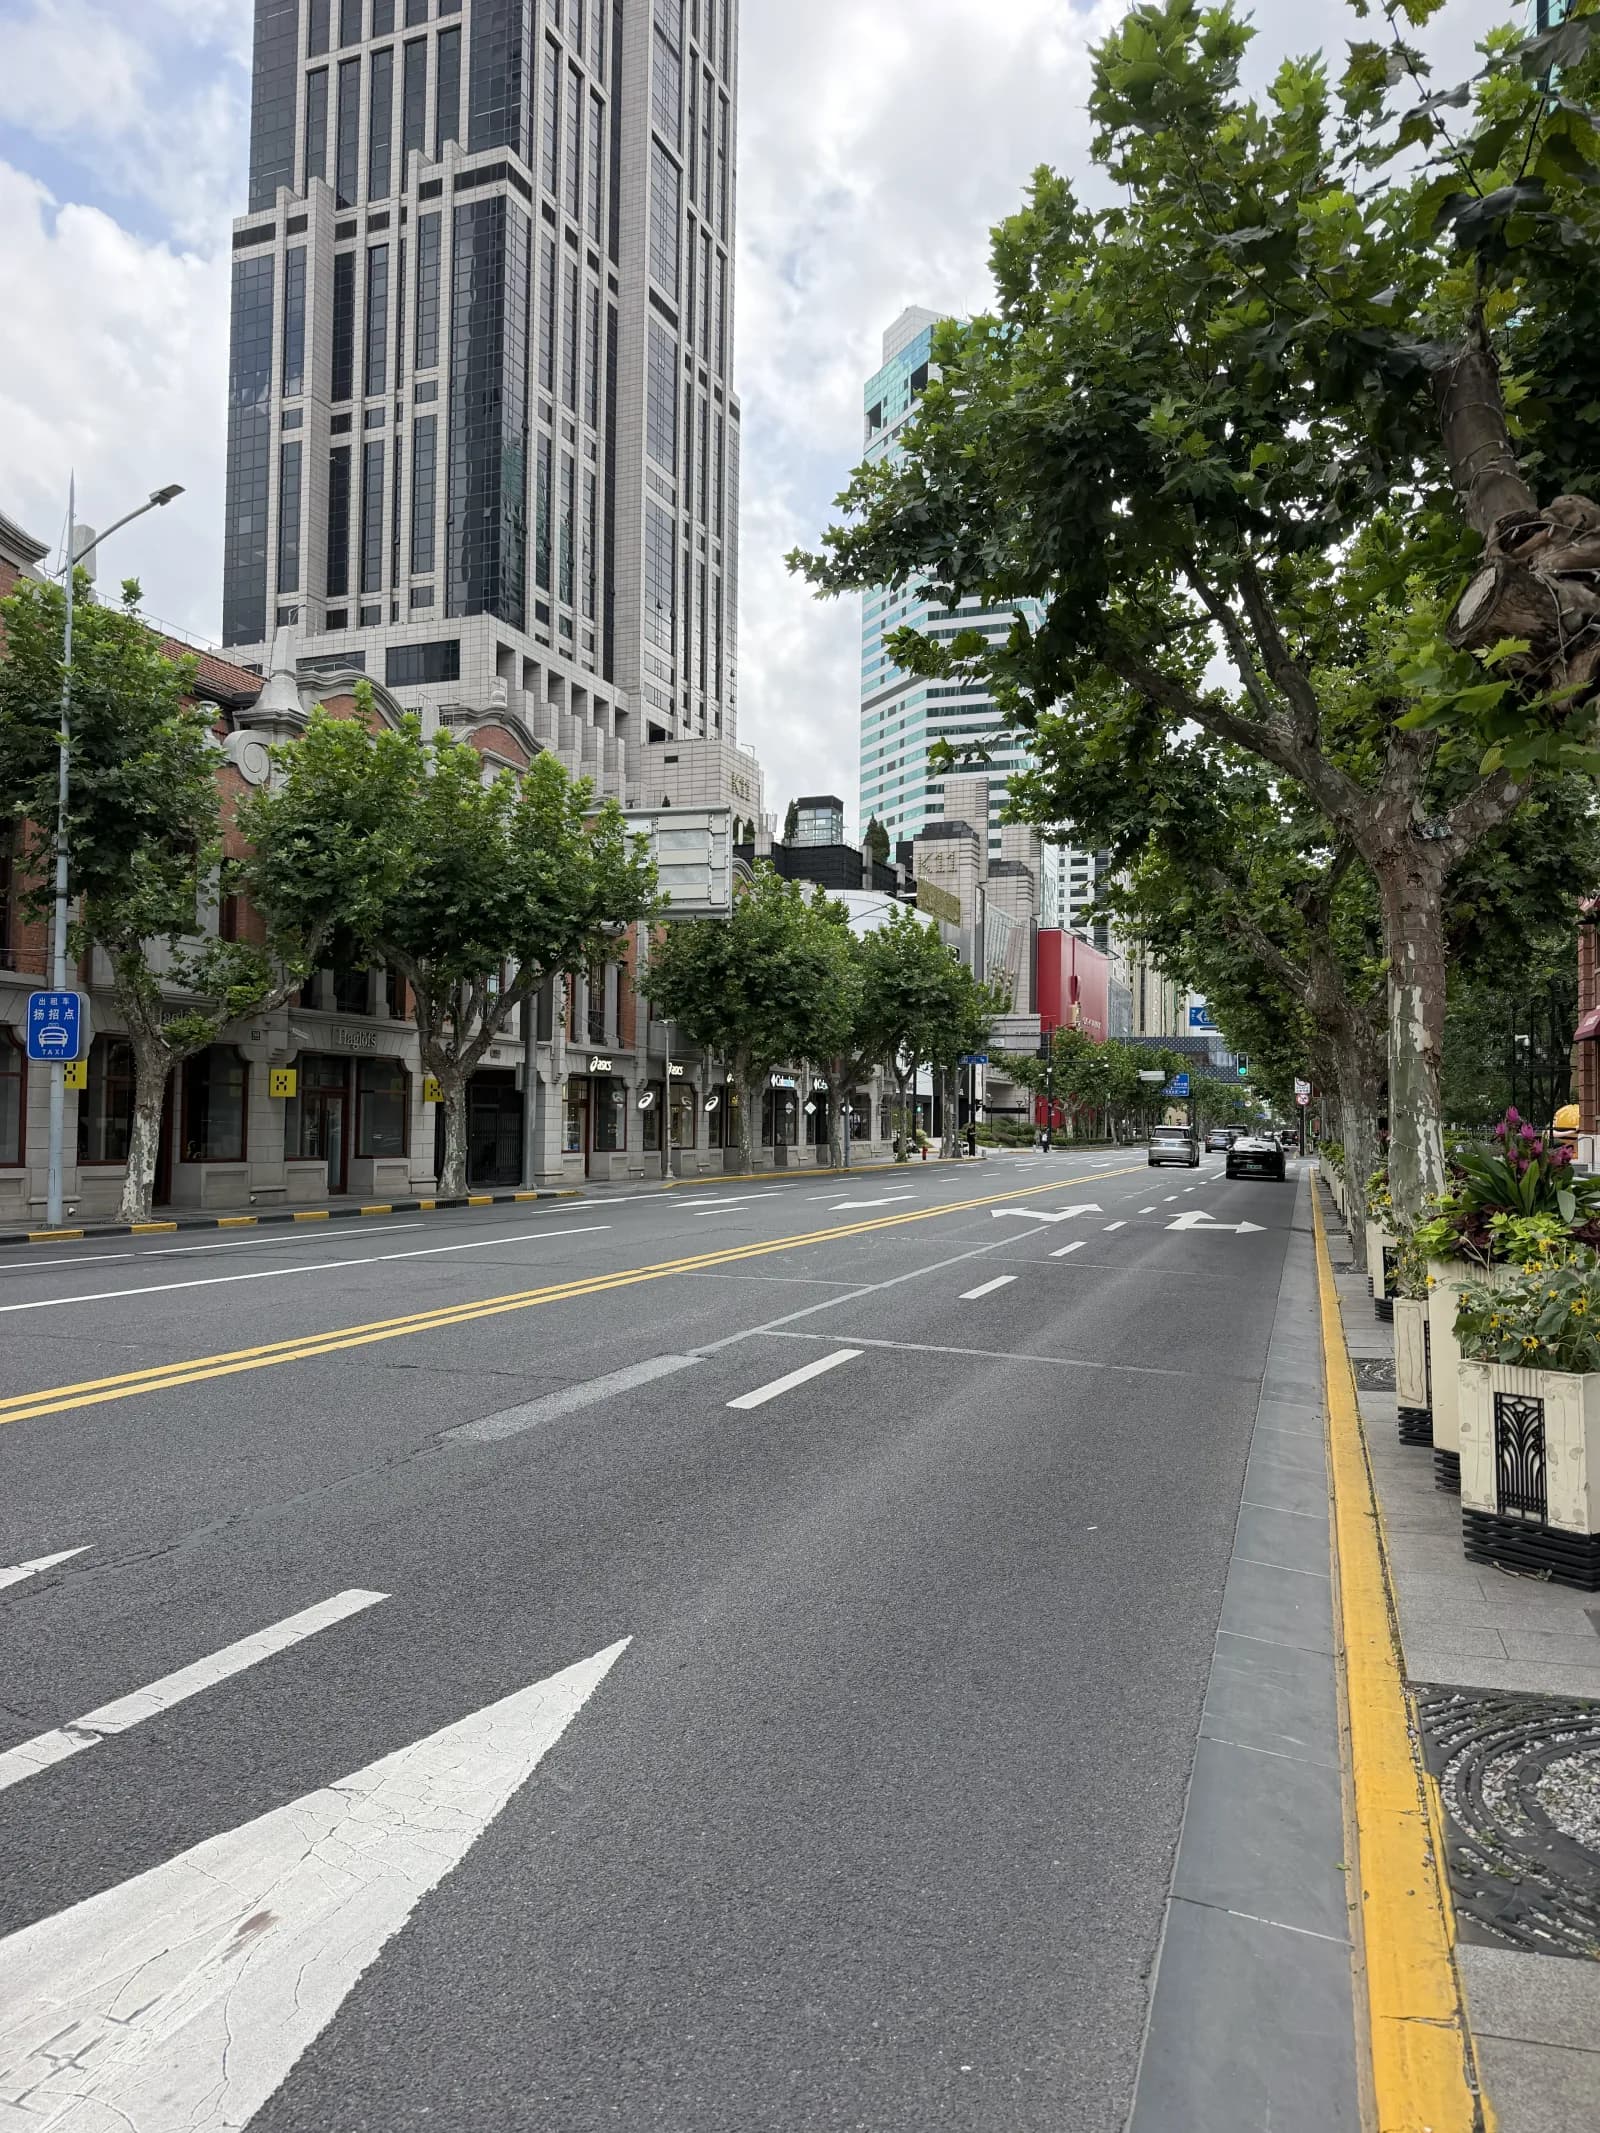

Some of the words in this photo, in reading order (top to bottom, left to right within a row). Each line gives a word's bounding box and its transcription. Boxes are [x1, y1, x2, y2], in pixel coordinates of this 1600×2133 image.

[918, 851, 957, 874] K11
[38, 997, 69, 1006] 出租车
[33, 1008, 75, 1021] 扬招点
